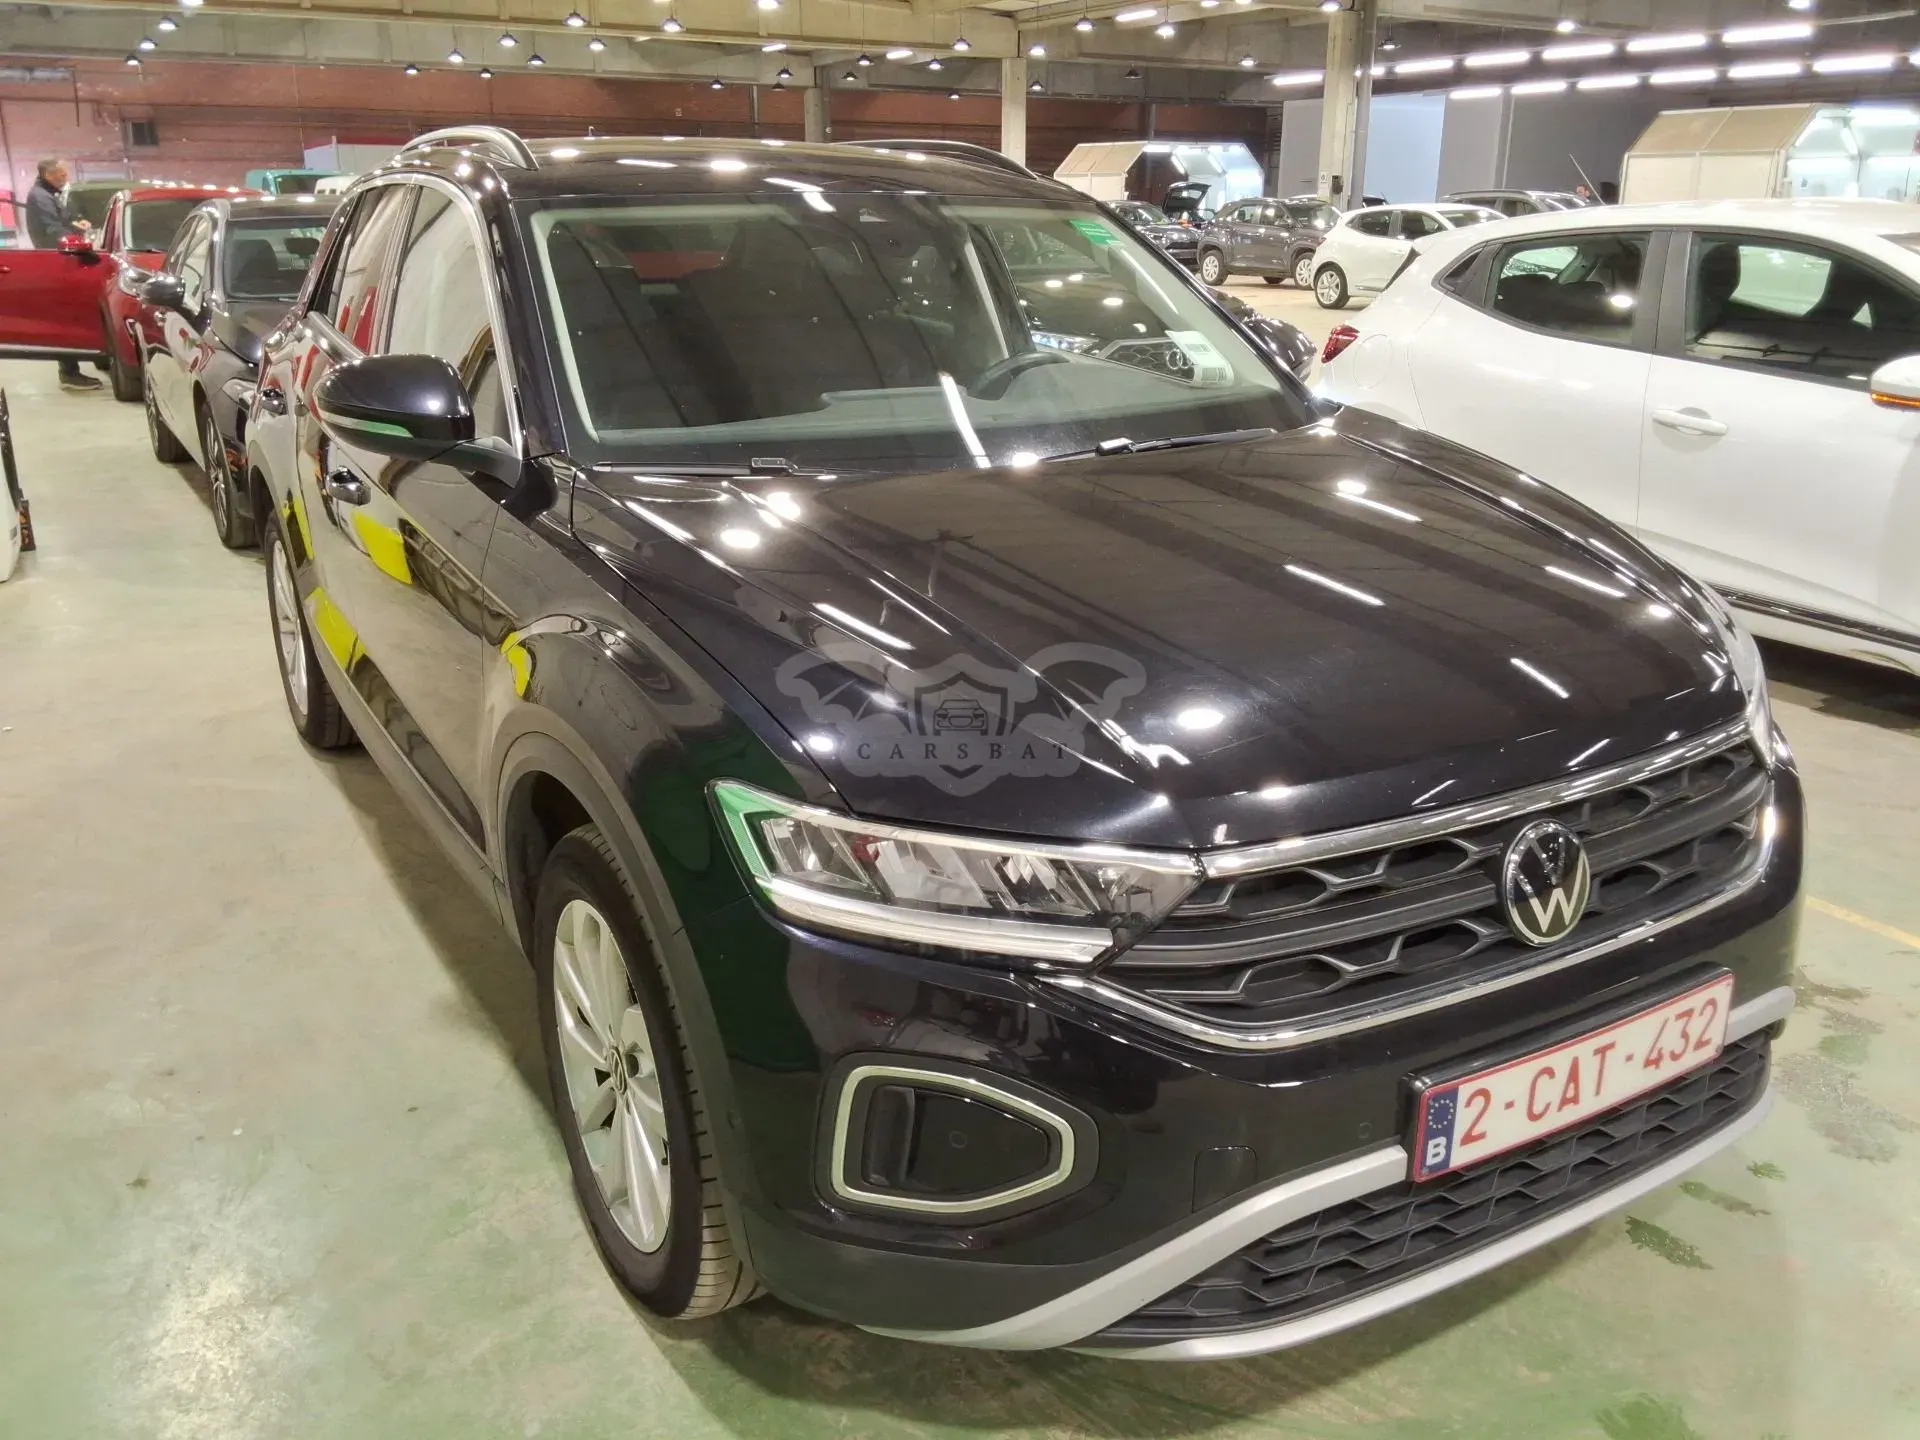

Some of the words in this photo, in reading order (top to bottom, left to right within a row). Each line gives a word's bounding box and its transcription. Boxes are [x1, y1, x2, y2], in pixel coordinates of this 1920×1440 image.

[1506, 825, 1588, 934] VW
[1459, 997, 1718, 1148] 2-CAT-432
[1425, 1135, 1448, 1166] B
